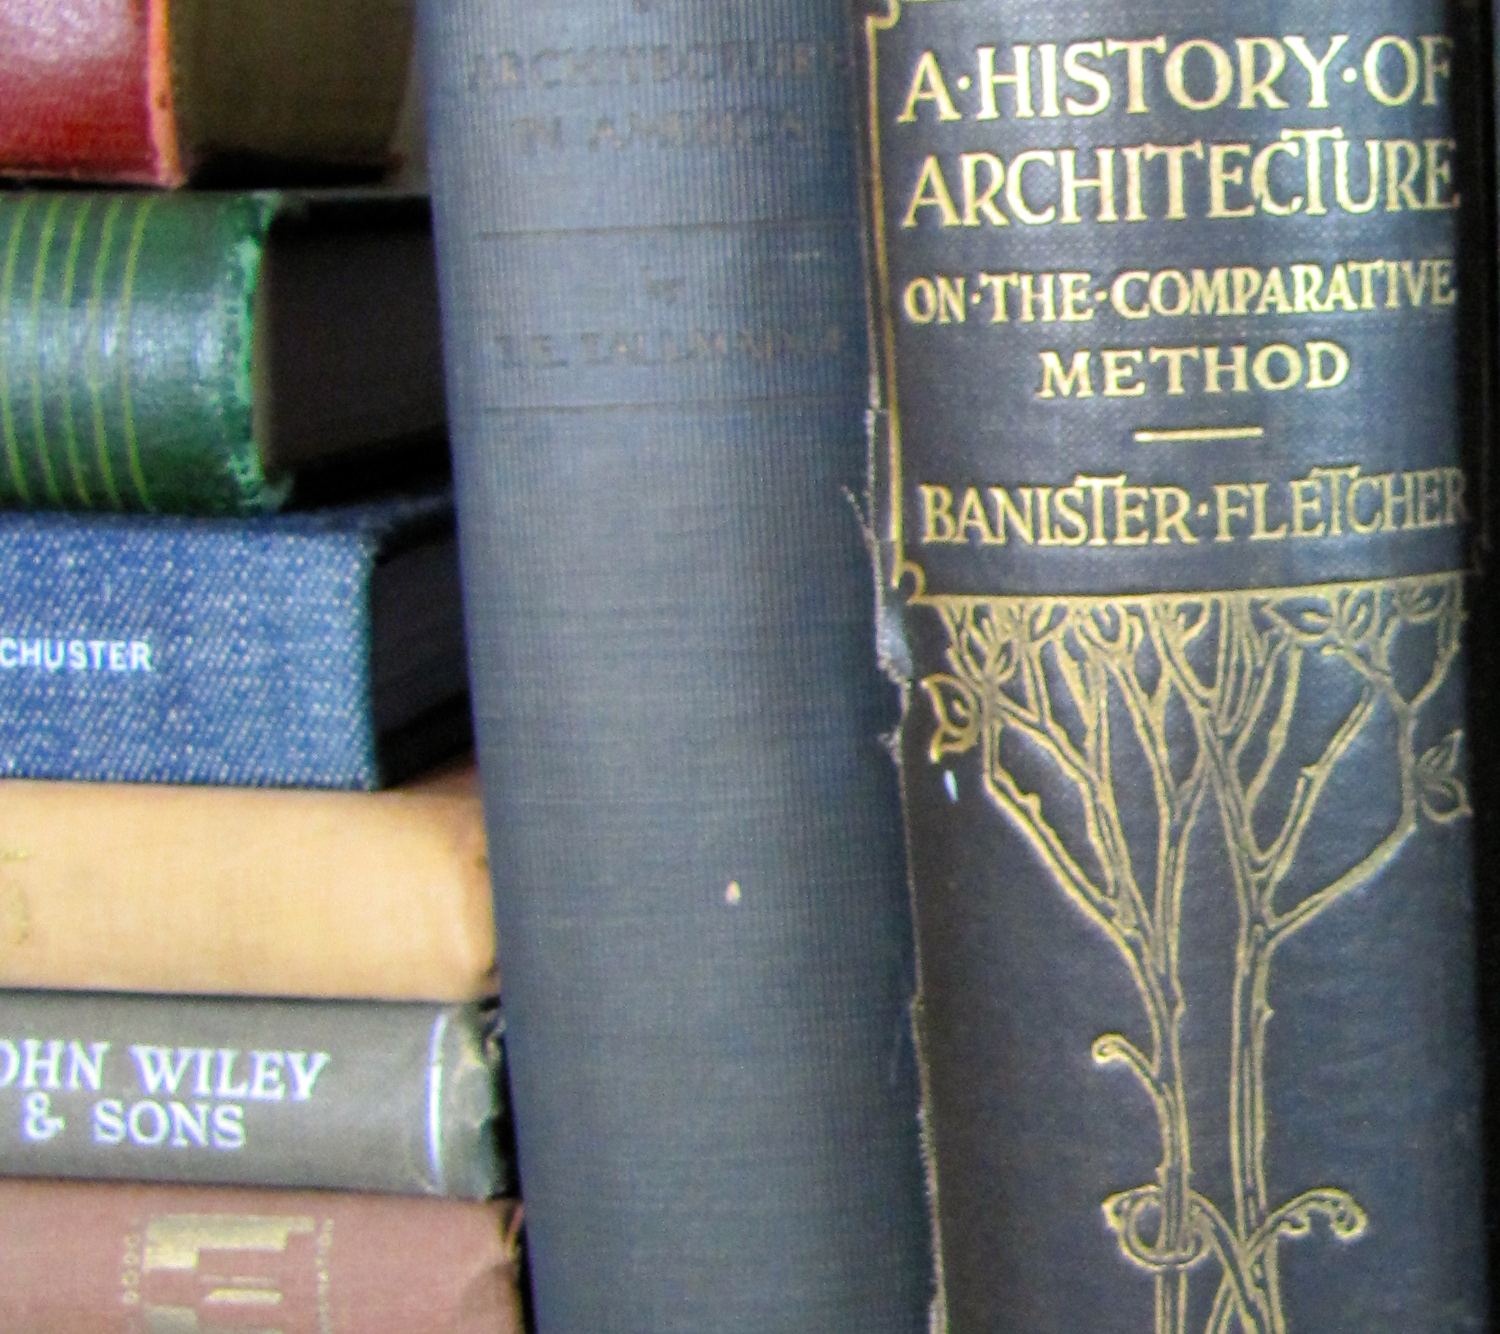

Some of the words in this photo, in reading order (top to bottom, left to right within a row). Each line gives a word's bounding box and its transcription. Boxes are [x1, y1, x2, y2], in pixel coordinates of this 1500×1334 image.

[901, 127, 1461, 227] ARCHITECTURE
[904, 275, 967, 325] ON
[979, 271, 1095, 324] THE
[1111, 260, 1458, 320] COMPARATIVE
[1037, 341, 1350, 399] METHOD
[919, 473, 1201, 546] BANISTER
[128, 1044, 331, 1102] WILEY
[22, 1091, 66, 1142] &
[92, 1098, 247, 1149] SONS
